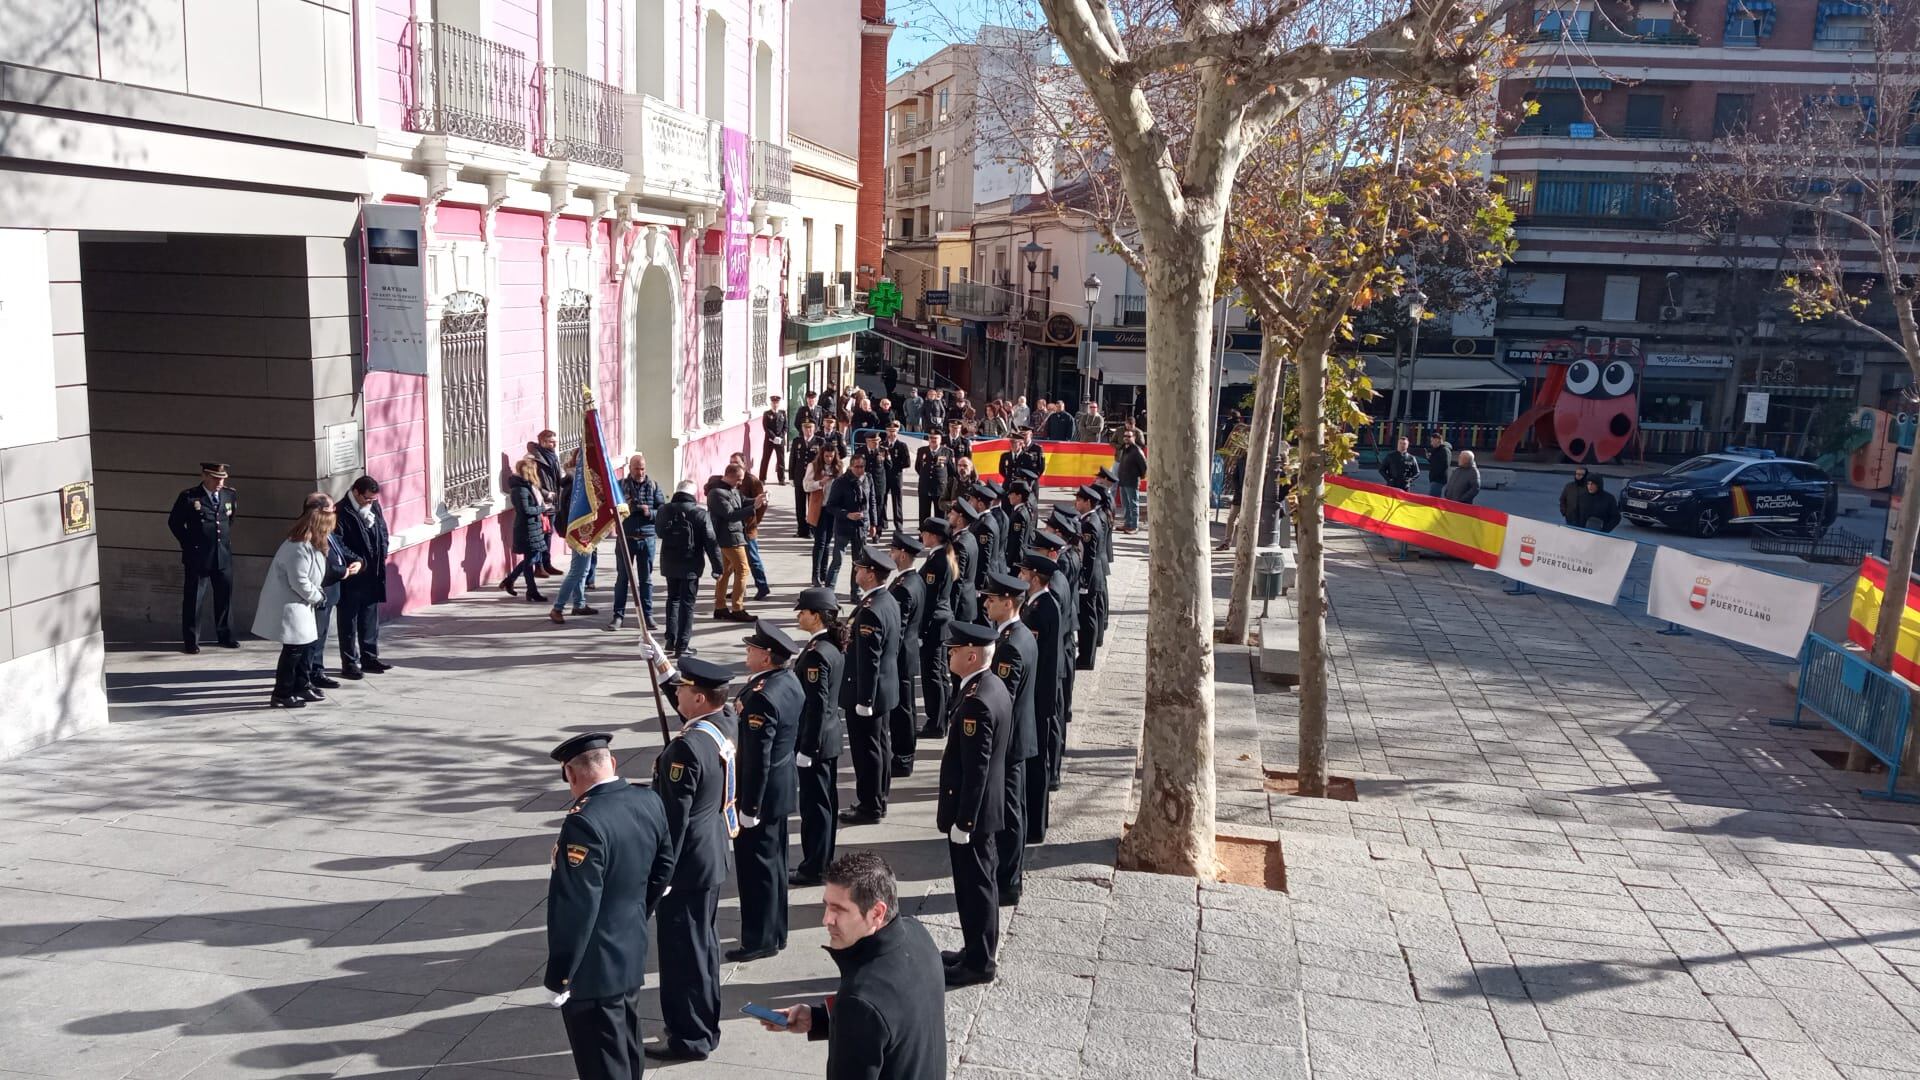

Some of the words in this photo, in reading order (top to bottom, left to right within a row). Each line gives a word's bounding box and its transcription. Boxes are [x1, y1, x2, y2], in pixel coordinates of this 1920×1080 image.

[1756, 501, 1804, 509] NACIONAL
[1537, 556, 1593, 575] PUERTOLLANO
[1710, 598, 1771, 622] PUERTOLLANO
